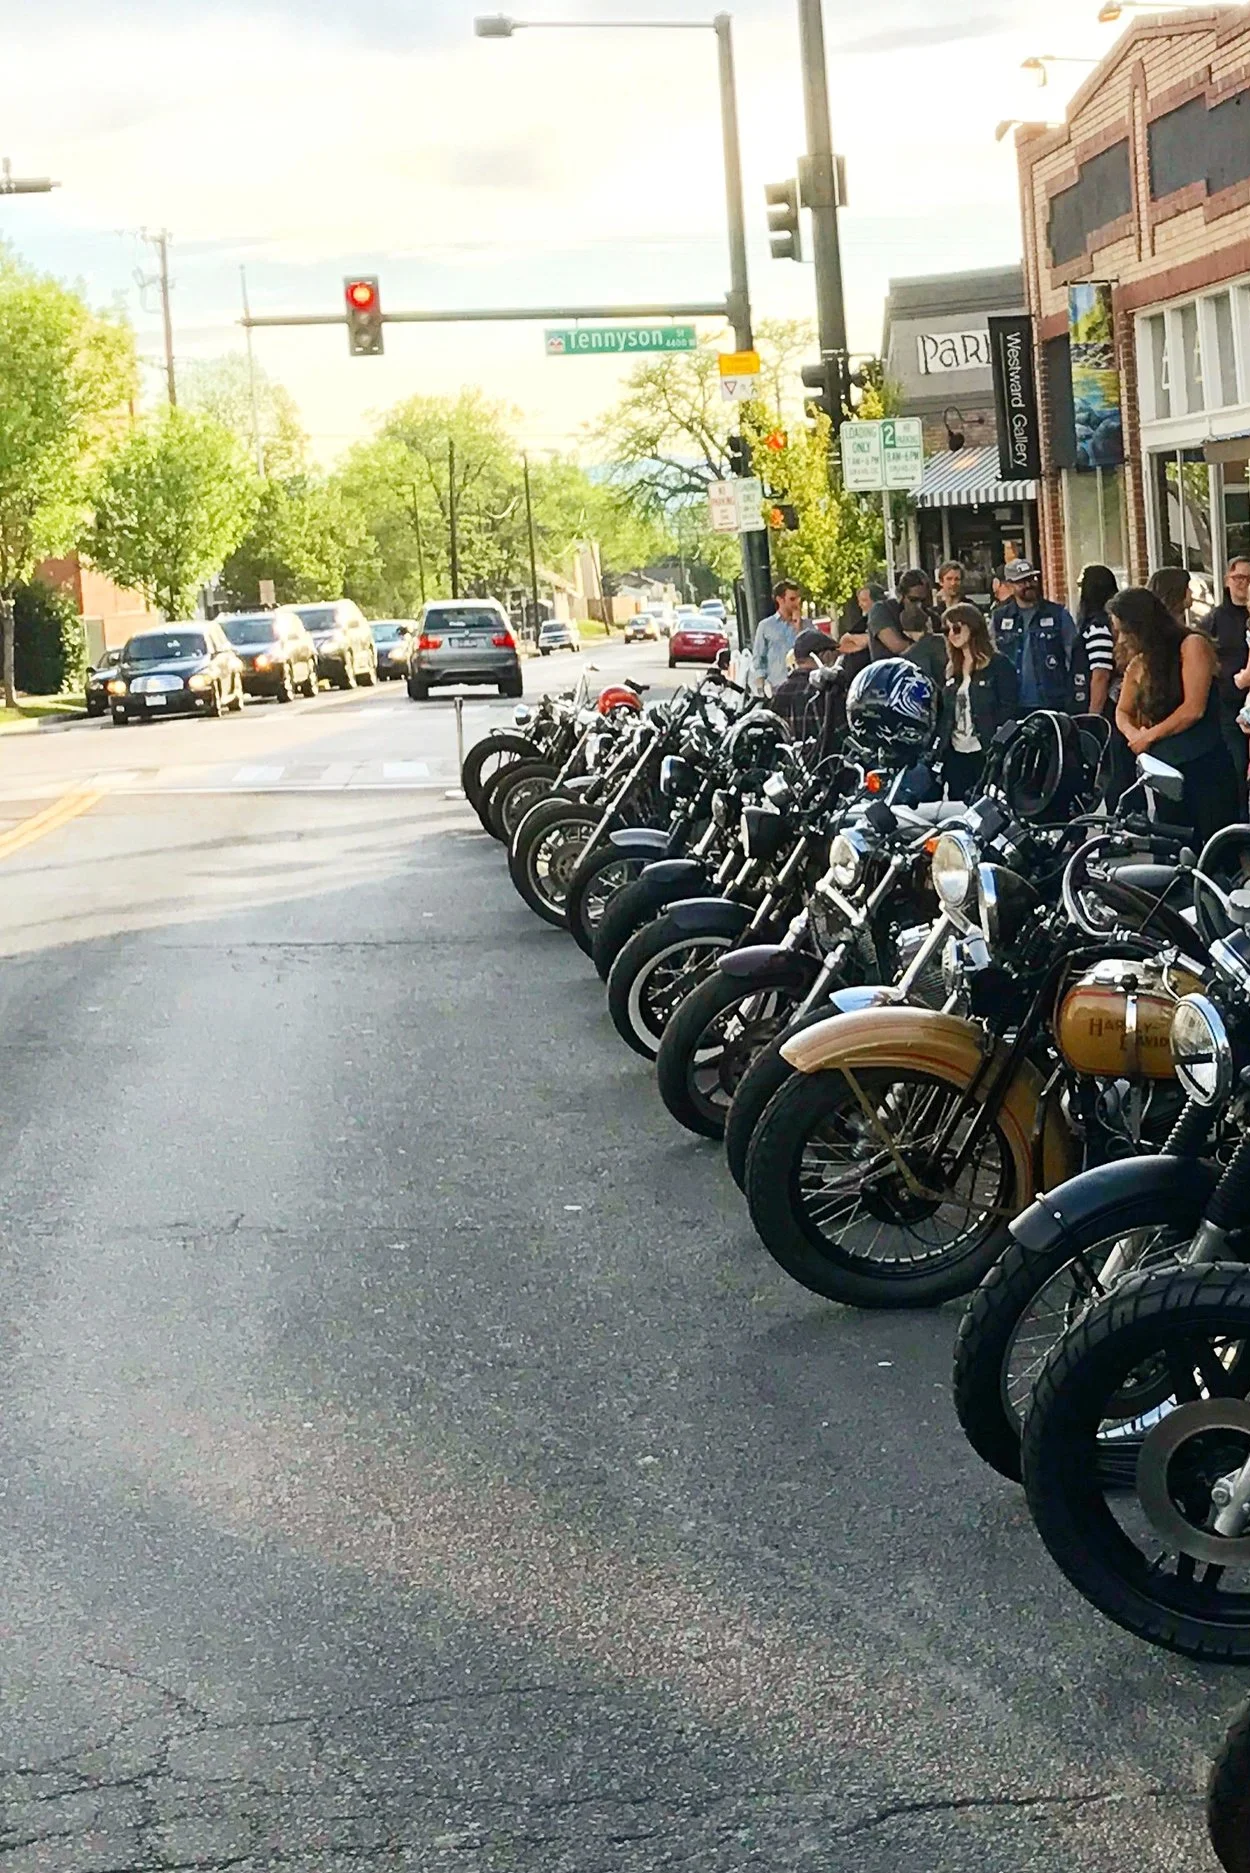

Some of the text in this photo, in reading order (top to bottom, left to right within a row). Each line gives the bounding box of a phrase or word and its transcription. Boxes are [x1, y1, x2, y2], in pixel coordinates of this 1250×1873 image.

[568, 329, 663, 351] Tennyson
[1006, 331, 1029, 468] Westward Gallery
[884, 425, 894, 445] 2
[852, 441, 870, 453] ONLY
